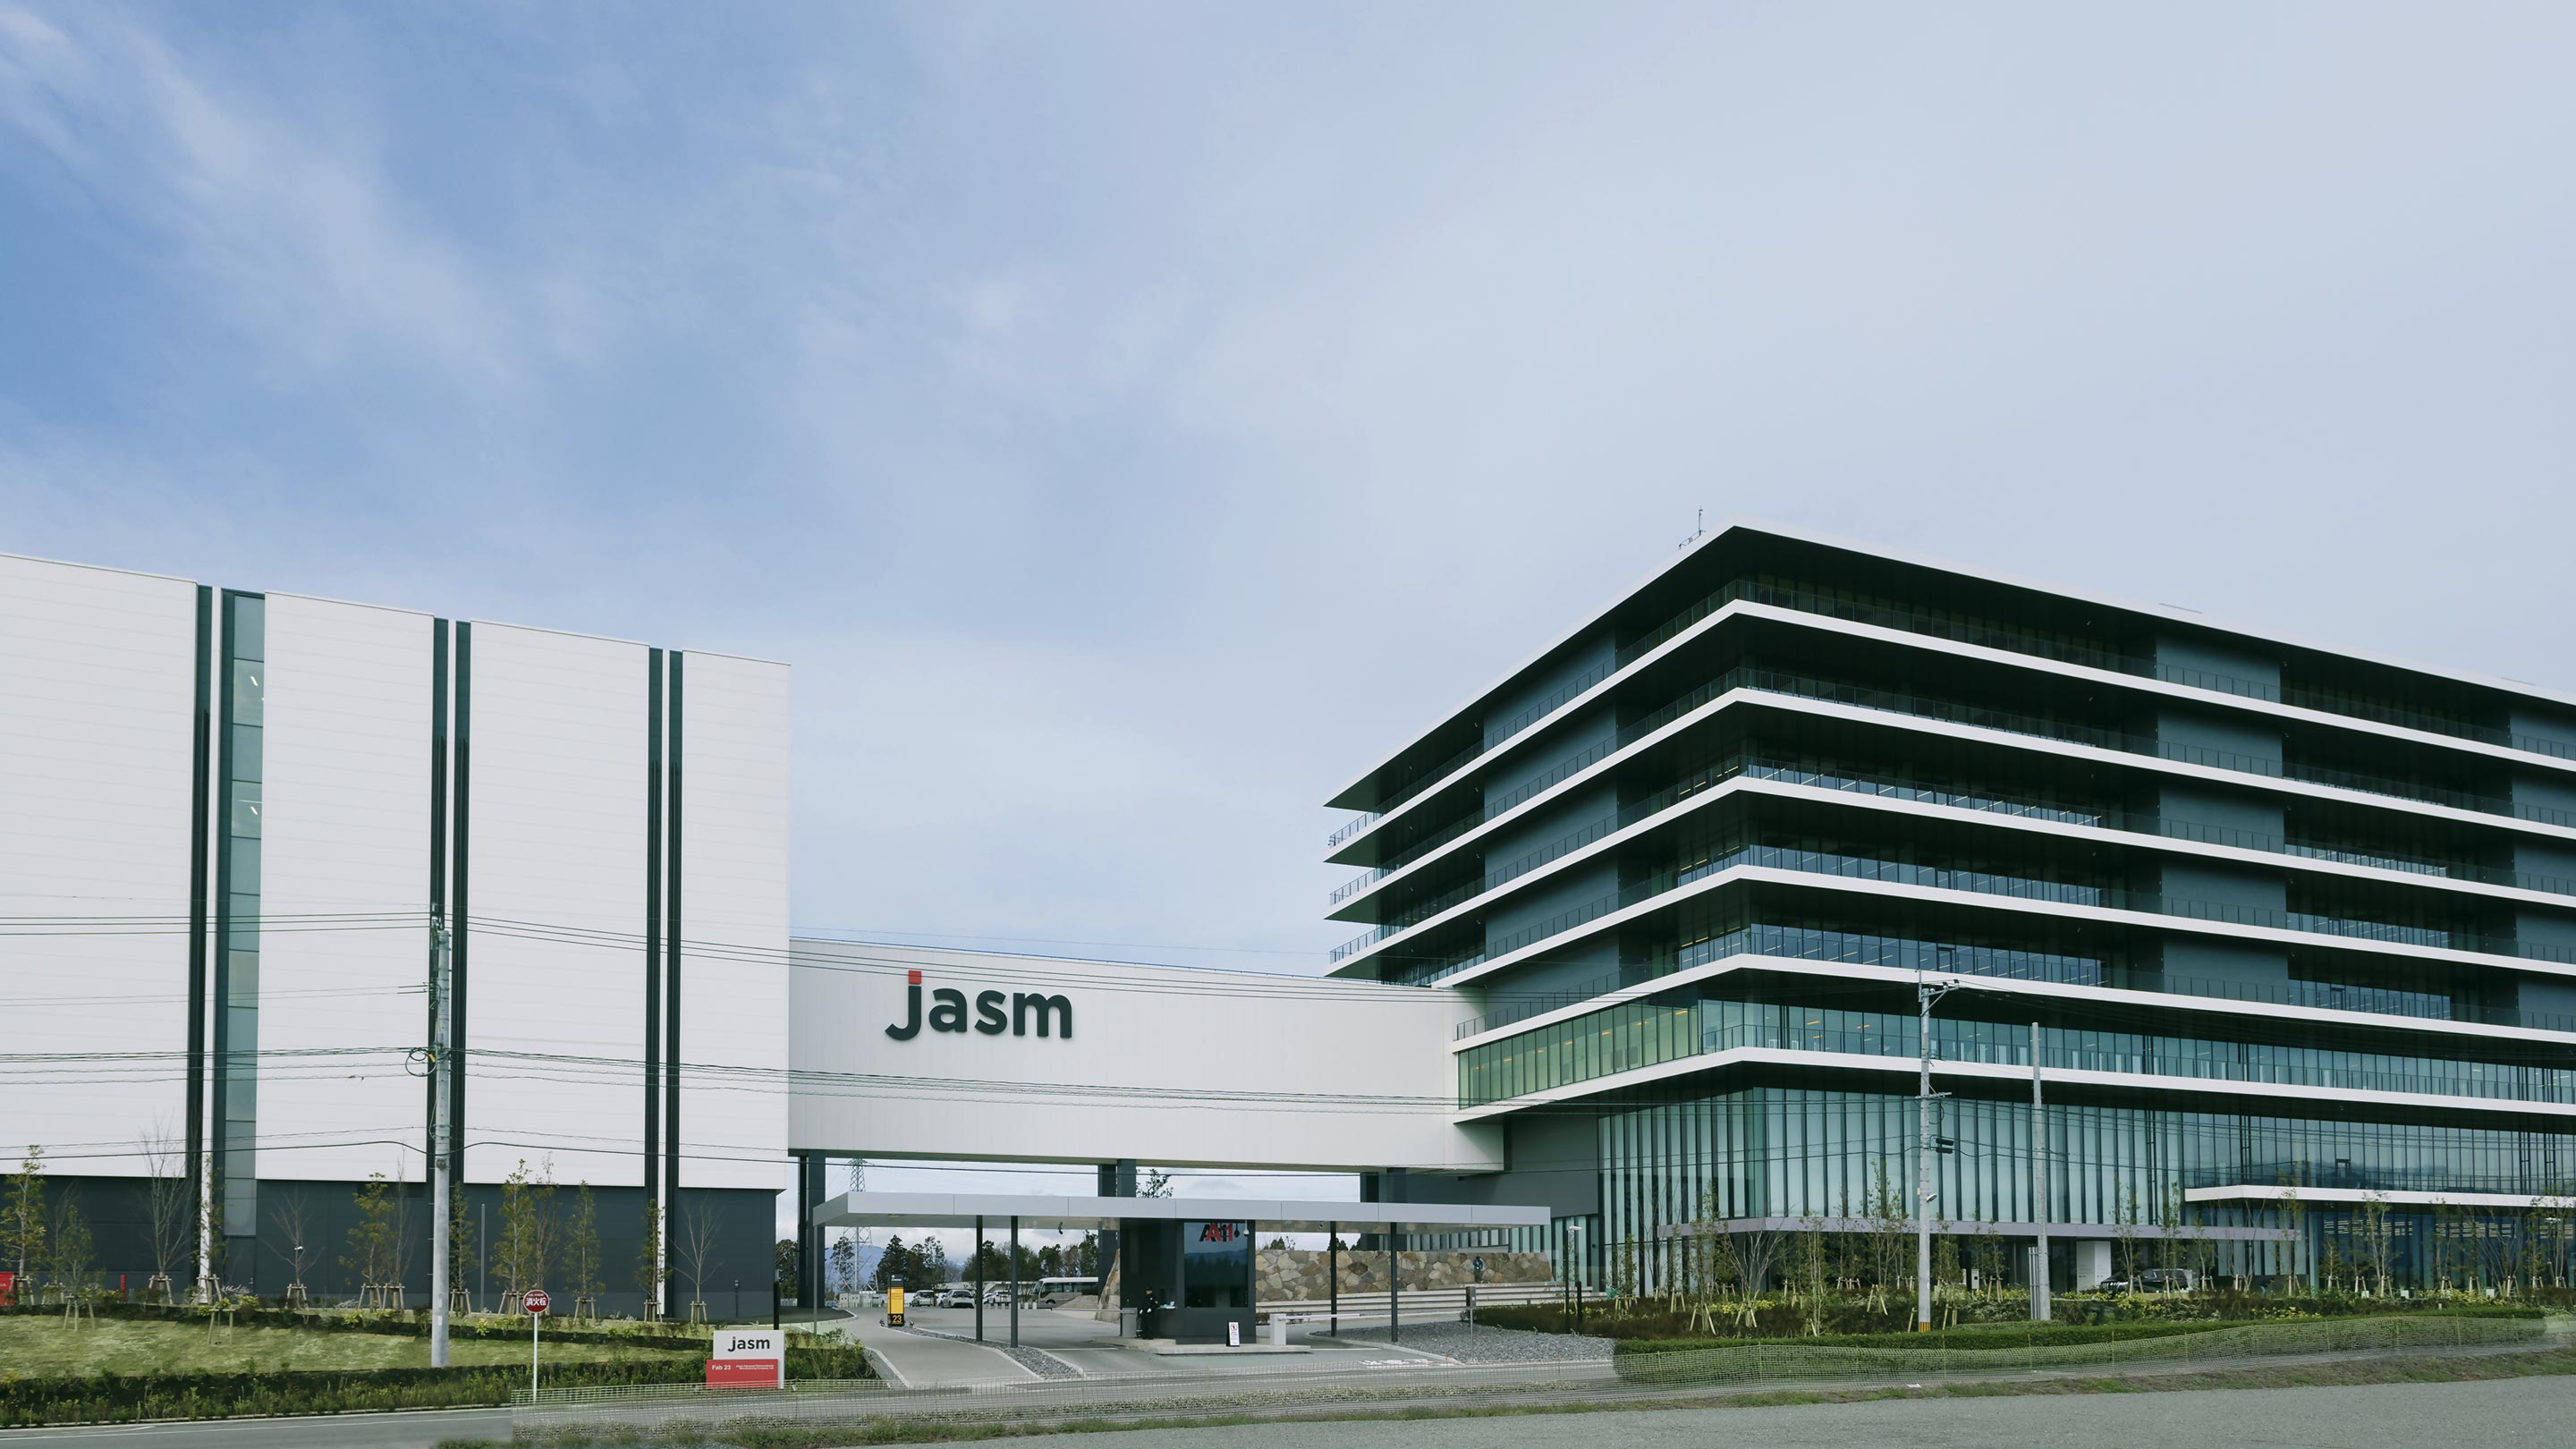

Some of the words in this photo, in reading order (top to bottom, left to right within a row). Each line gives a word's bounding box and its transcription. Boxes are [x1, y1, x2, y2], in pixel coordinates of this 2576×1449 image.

[885, 970, 1072, 1041] jasm
[526, 1297, 547, 1306] 消火栓
[892, 1315, 902, 1323] 23
[727, 1336, 770, 1352] jasm
